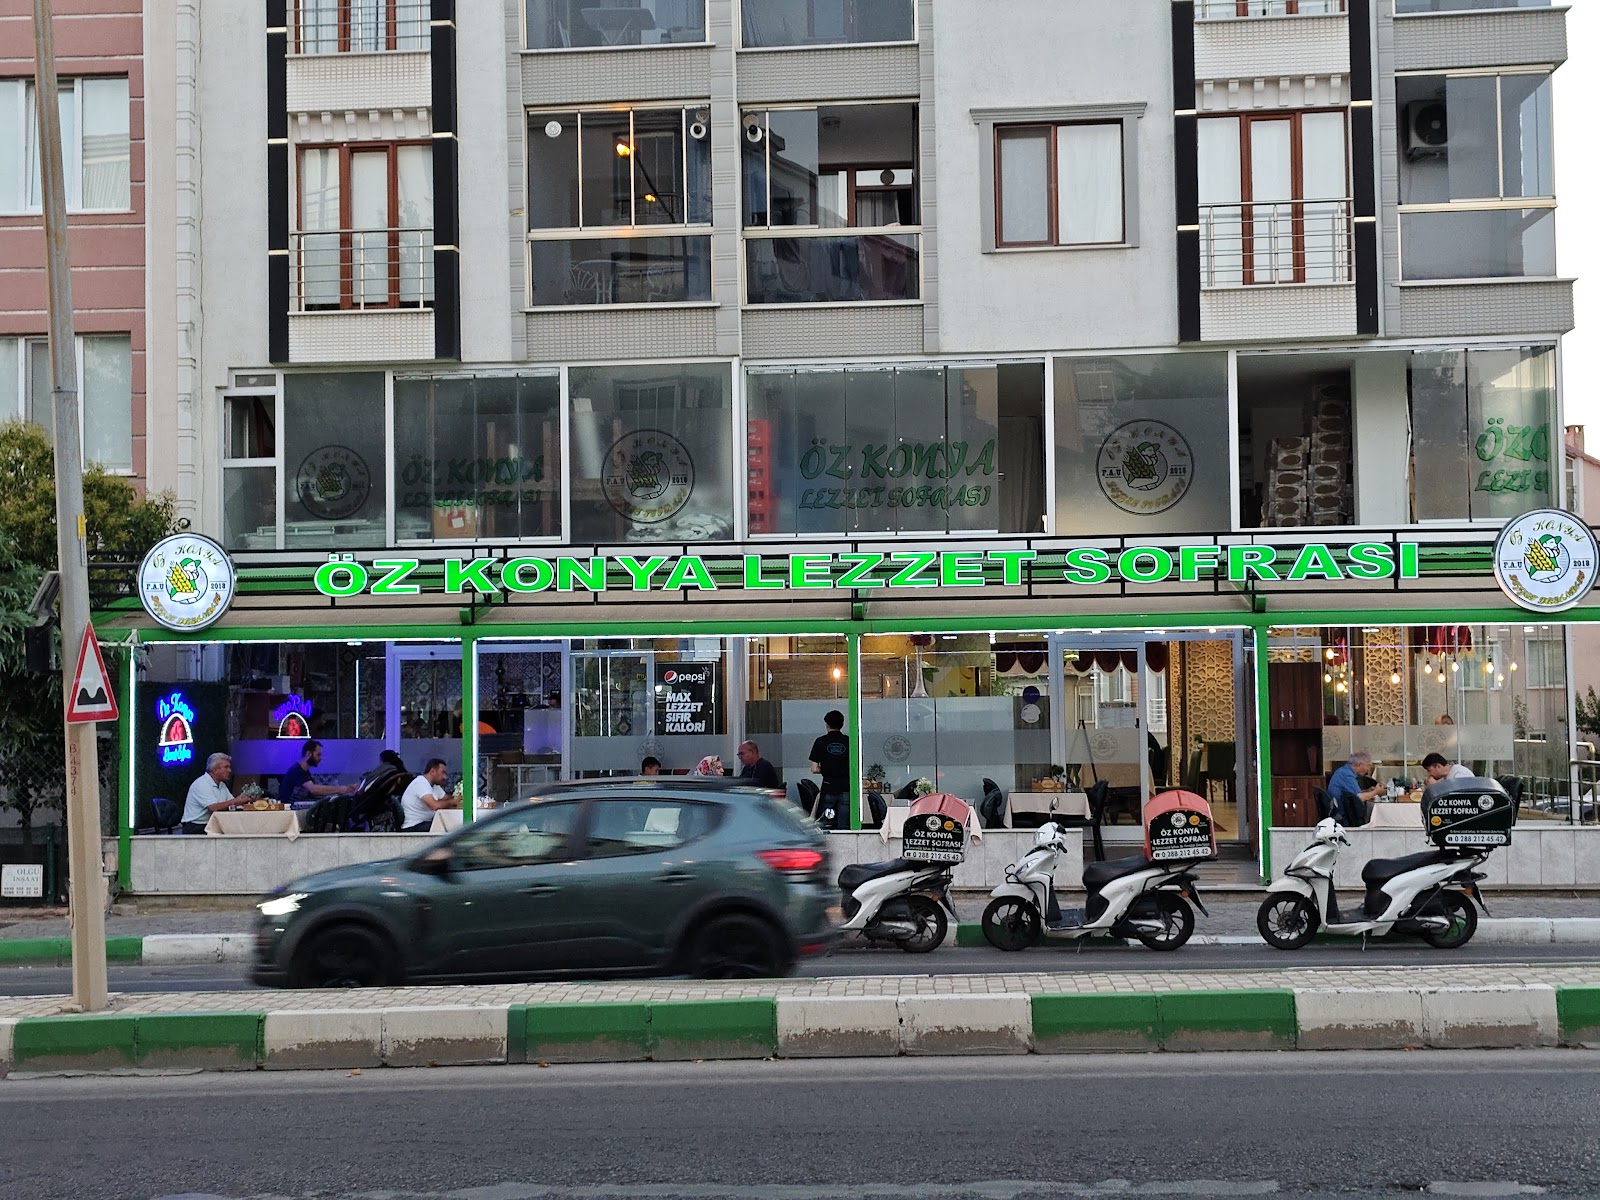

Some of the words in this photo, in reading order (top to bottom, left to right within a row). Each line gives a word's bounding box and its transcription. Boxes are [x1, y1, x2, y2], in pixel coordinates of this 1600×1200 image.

[800, 438, 853, 479] ÖZ
[860, 439, 996, 479] KONYA
[799, 486, 886, 510] LEZZET
[887, 484, 992, 510] SOFRASI
[314, 553, 422, 597] ÖZ
[444, 555, 718, 594] KONYA
[743, 551, 1037, 590] LEZZET
[1063, 542, 1420, 583] SOFRASI
[210, 582, 226, 590] 2018
[679, 672, 706, 683] pepsi
[666, 692, 691, 703] MAX
[666, 702, 703, 712] LEZZET
[665, 712, 691, 722] SIFIR
[665, 720, 706, 732] KALORİ
[1438, 798, 1448, 806] ÖZ
[914, 829, 925, 837] ÖZ
[927, 831, 953, 839] KONYA
[1160, 828, 1171, 836] ÖZ
[1173, 827, 1200, 836] KONYA
[1178, 834, 1209, 844] SOFRASI
